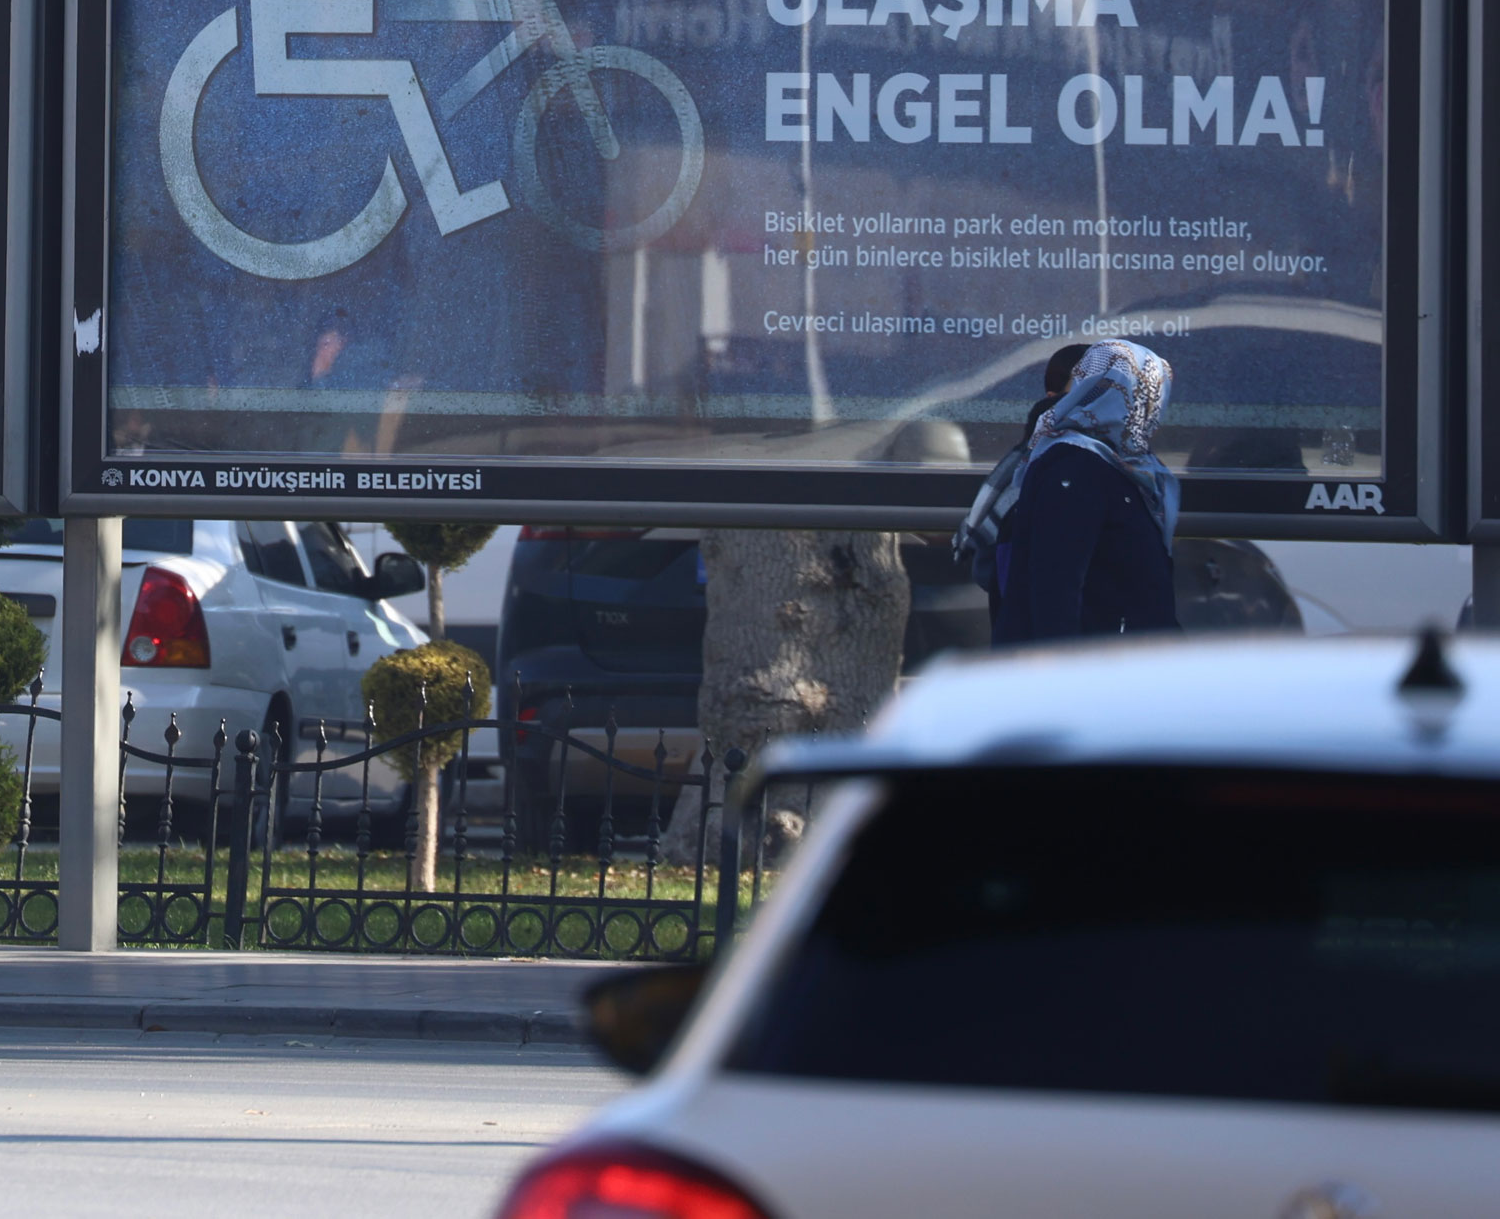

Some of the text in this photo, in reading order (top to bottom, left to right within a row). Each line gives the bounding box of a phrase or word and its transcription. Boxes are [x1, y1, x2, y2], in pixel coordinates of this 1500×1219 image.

[764, 71, 1326, 147] ENGEL OLMA!
[764, 211, 1252, 241] Bisiklet yollarına park eden motorlu taşıtlar,
[763, 245, 1328, 275] her gün binlerce bisiklet kullanıcısına engel oluyor.
[763, 310, 1190, 339] Çevreci ulaşıma engel değil, destek ol!
[129, 467, 482, 493] KONYA BÜYÜKŞEHİR BELEDİYESİ
[1304, 483, 1386, 515] AAR
